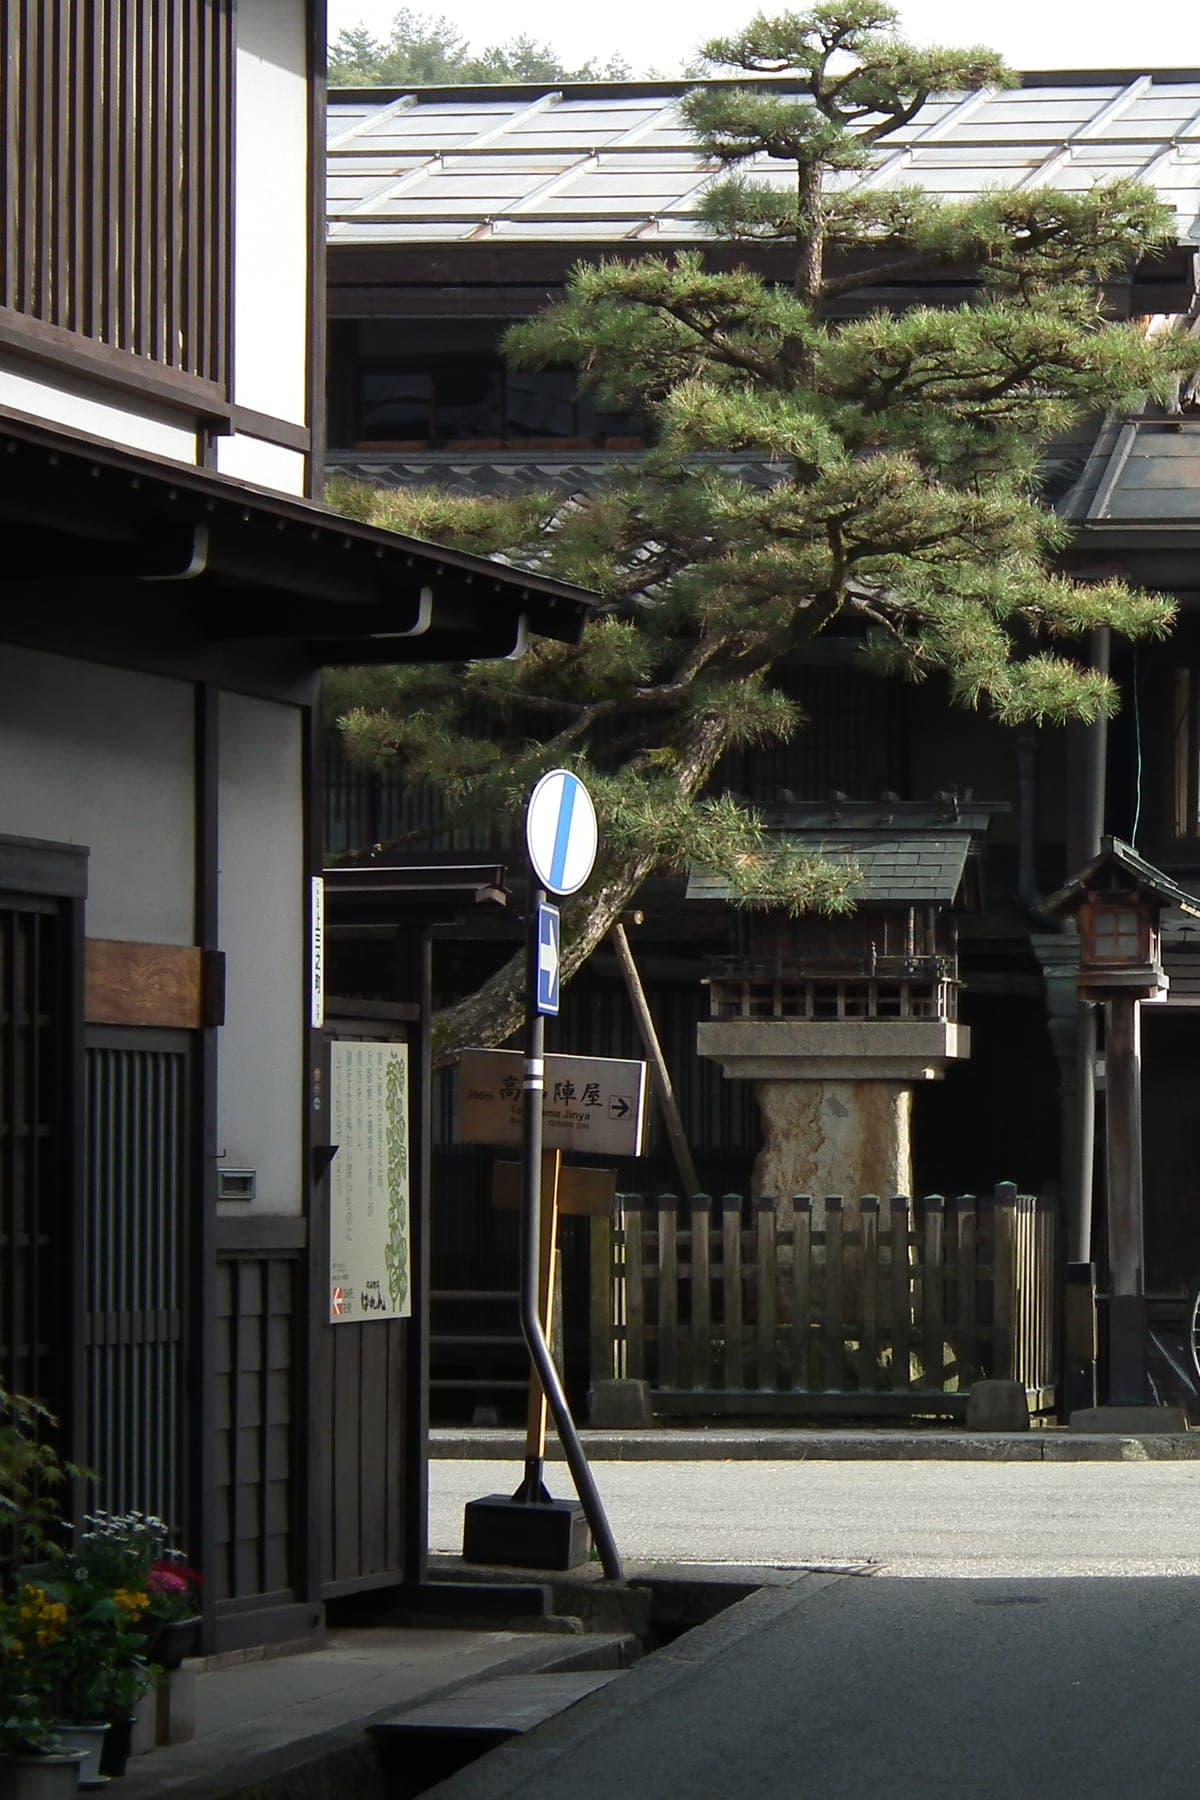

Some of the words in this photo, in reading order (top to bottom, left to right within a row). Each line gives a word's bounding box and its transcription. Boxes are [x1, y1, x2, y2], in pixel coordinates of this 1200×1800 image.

[500, 1074, 602, 1107] 高陣屋
[563, 1109, 591, 1121] Jinya
